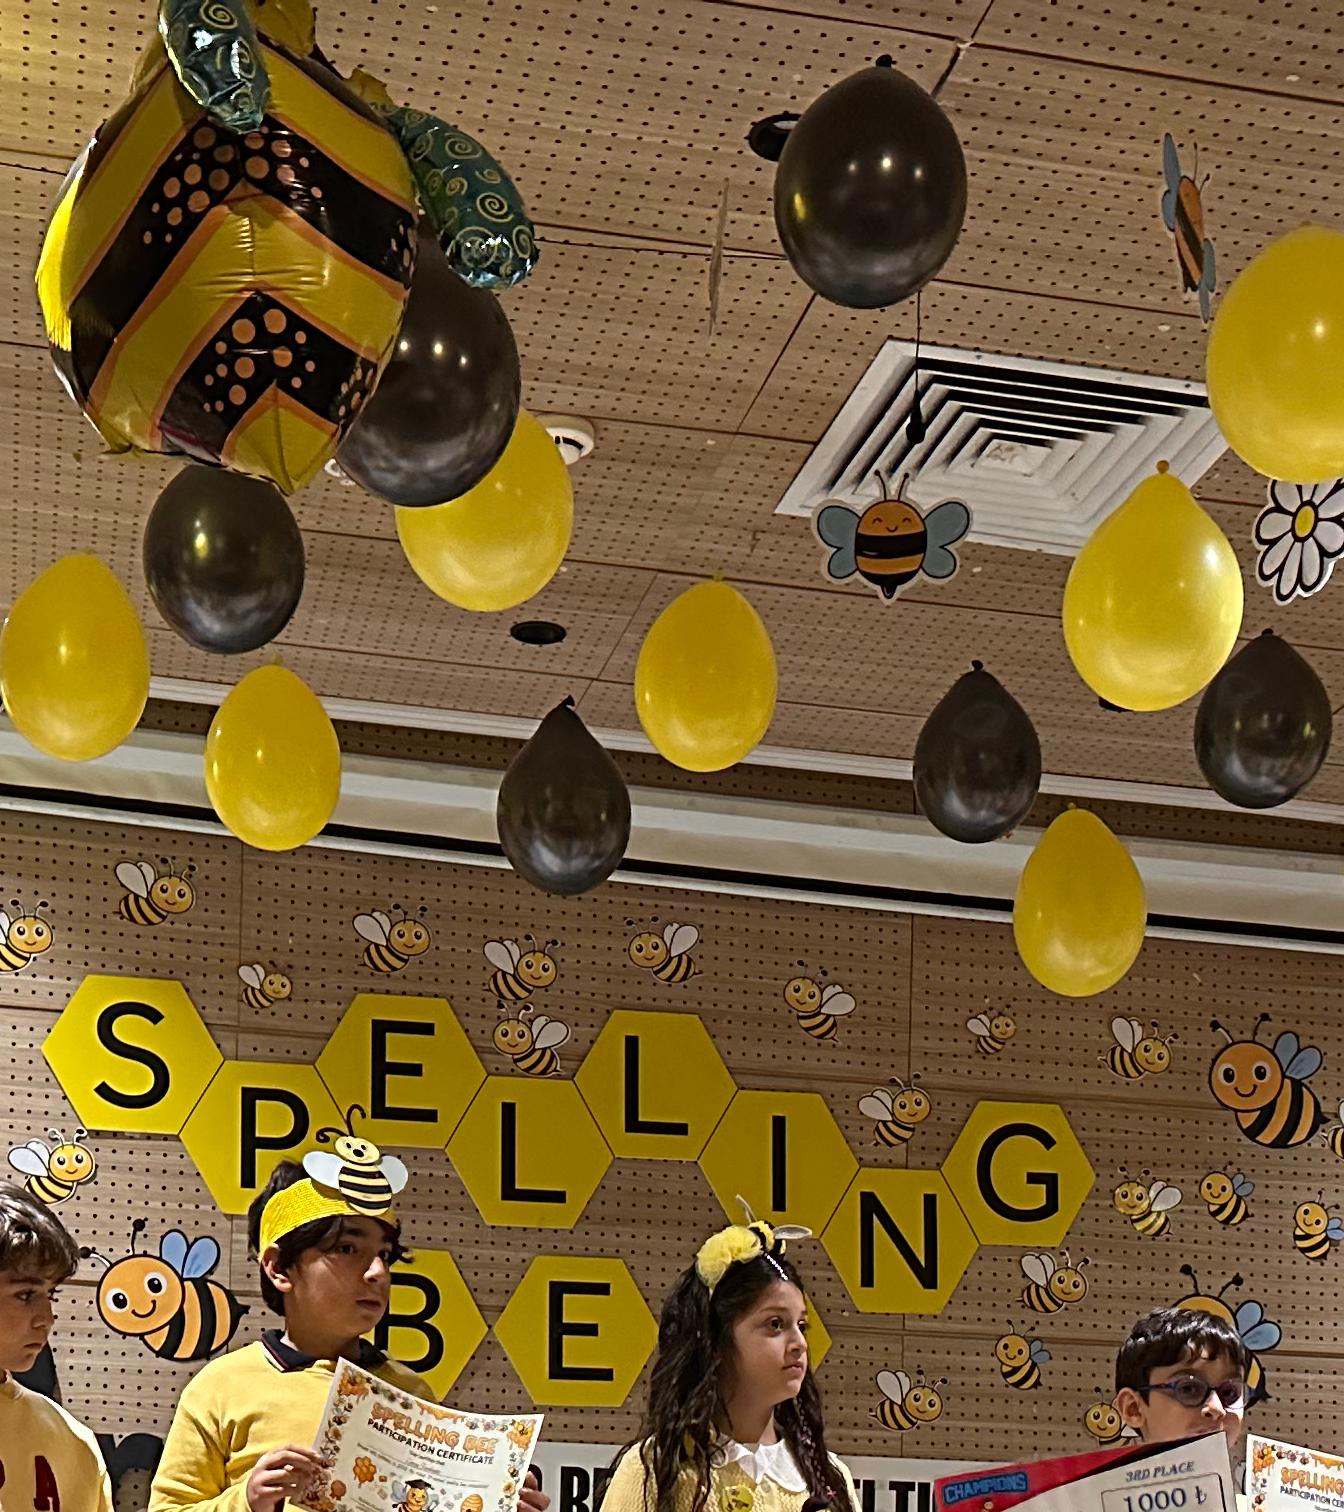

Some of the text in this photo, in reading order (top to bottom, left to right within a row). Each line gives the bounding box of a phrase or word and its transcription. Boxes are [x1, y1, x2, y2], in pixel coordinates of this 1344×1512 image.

[94, 1000, 1060, 1291] SPELLING
[374, 1278, 614, 1382] BE
[368, 1419, 495, 1465] PARTICIPATION CERTIFICATE
[371, 1402, 498, 1455] SPELLING BEE
[945, 1474, 1027, 1503] CHAMPIONS
[1125, 1461, 1194, 1482] 3RD PLACE
[1280, 1467, 1344, 1498] SPELLING
[1279, 1486, 1331, 1505] PARTICIPATION
